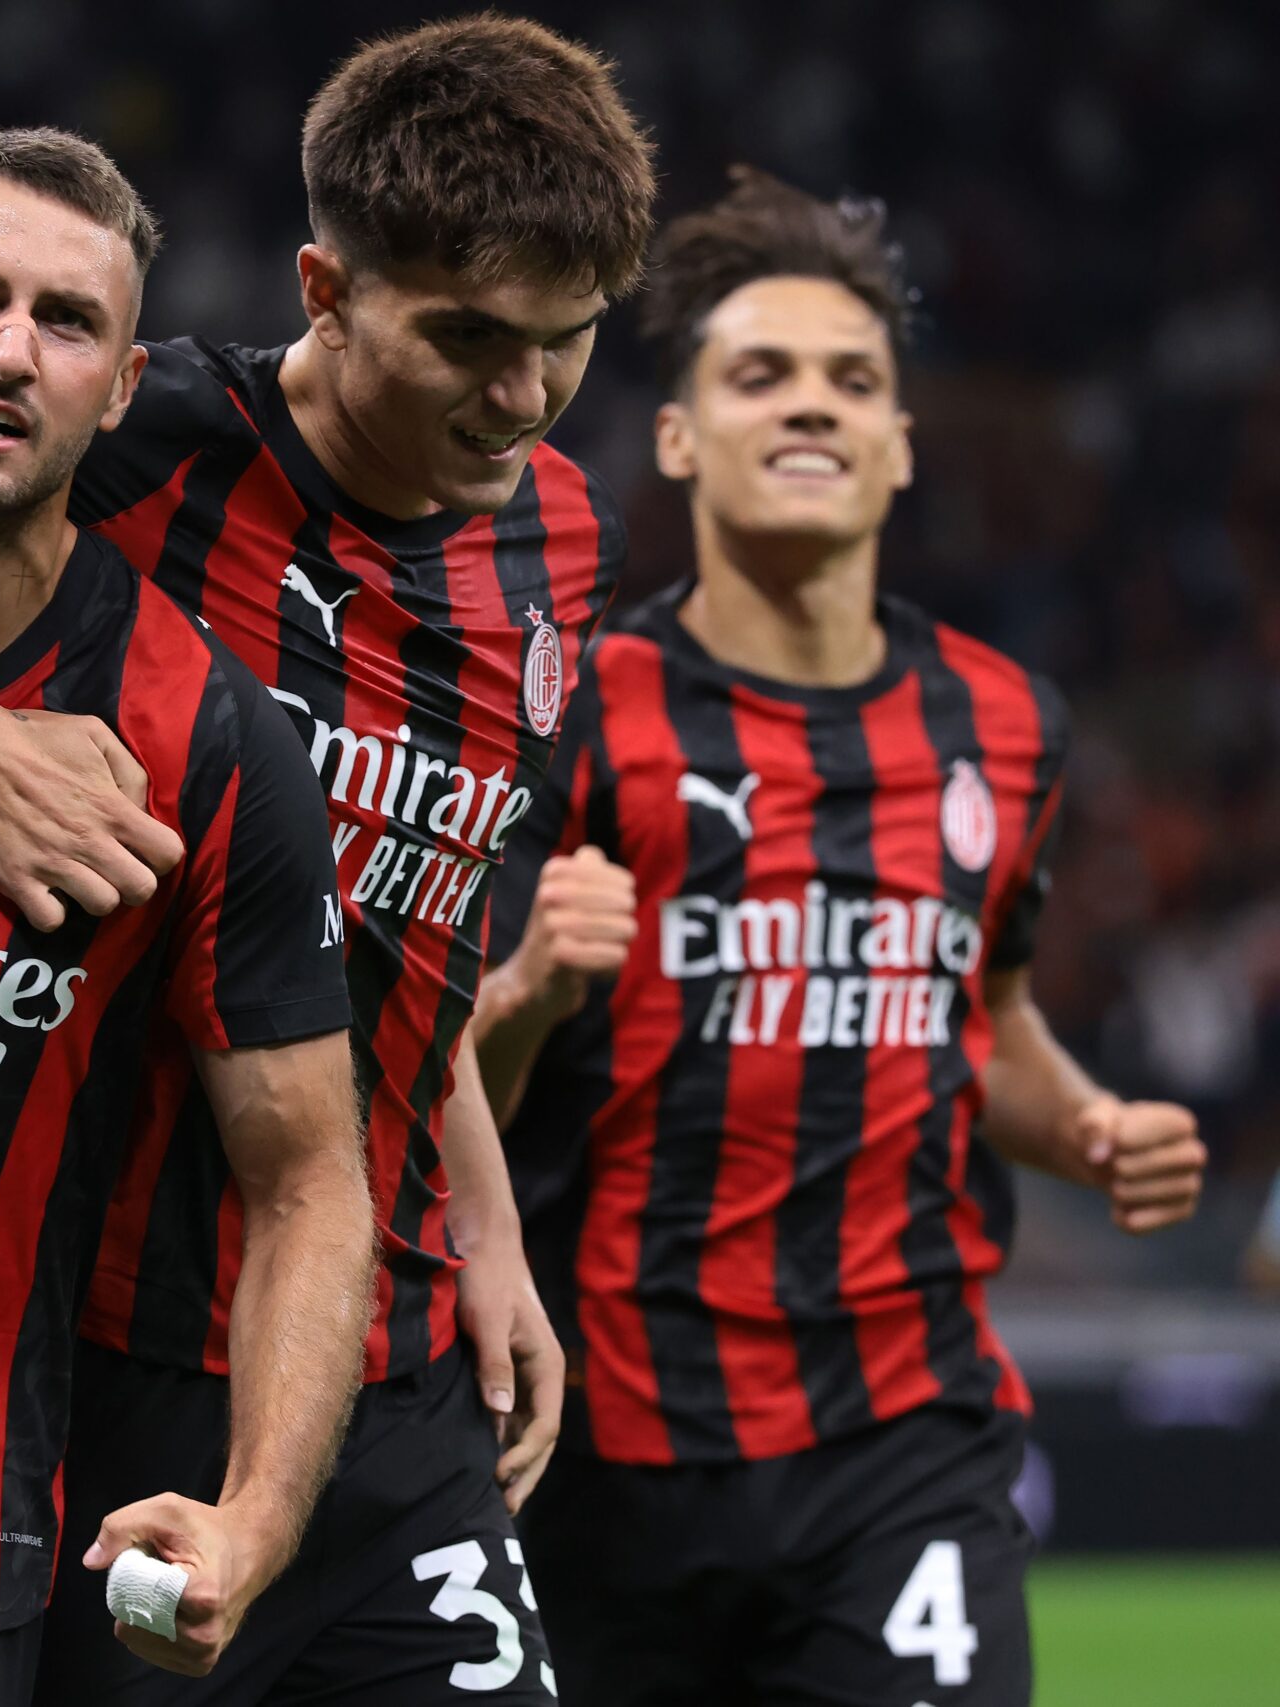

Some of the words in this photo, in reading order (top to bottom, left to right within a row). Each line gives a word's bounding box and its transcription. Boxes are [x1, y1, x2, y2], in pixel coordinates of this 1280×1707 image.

[265, 686, 534, 852] mirate
[349, 834, 490, 926] BETTER
[700, 975, 794, 1046] FLY
[882, 1539, 979, 1686] 4
